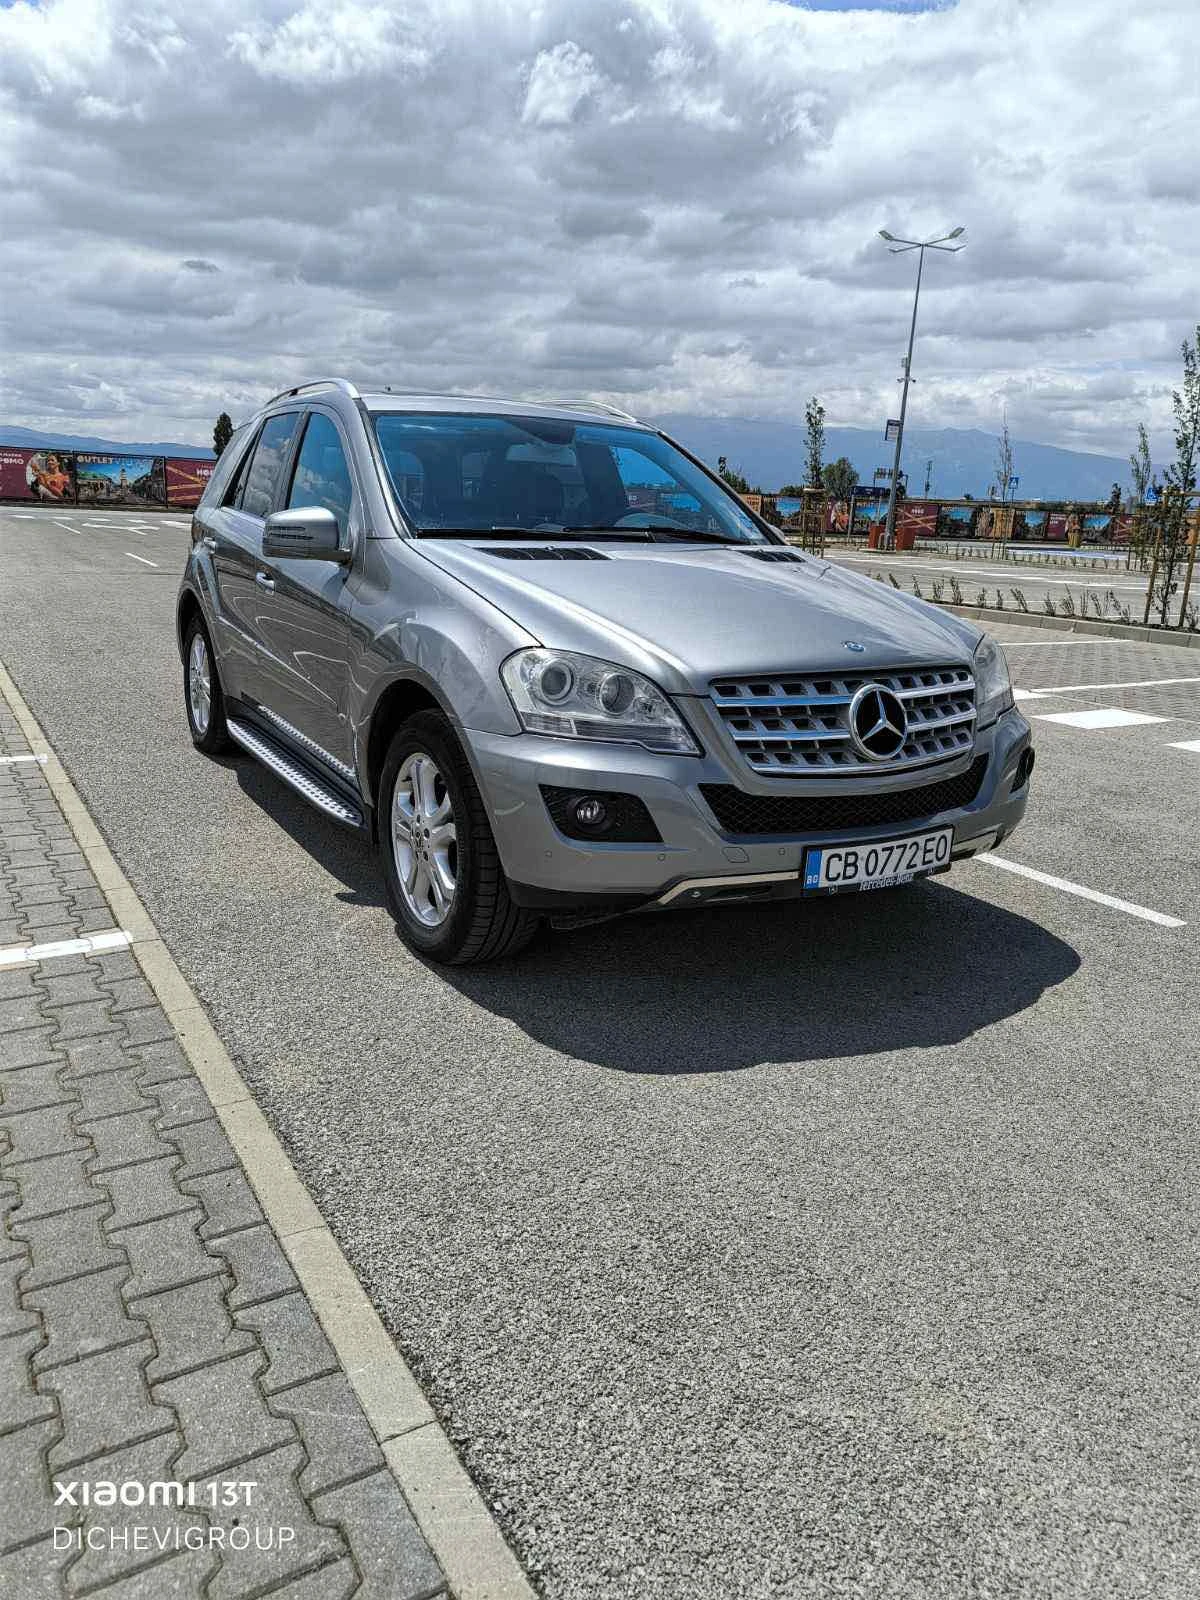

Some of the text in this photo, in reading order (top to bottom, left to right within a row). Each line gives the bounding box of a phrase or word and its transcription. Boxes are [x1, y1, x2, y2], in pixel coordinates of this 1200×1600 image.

[77, 455, 113, 464] OUTLET
[825, 851, 859, 883] CB
[864, 841, 920, 877] 0772
[806, 874, 819, 885] BG
